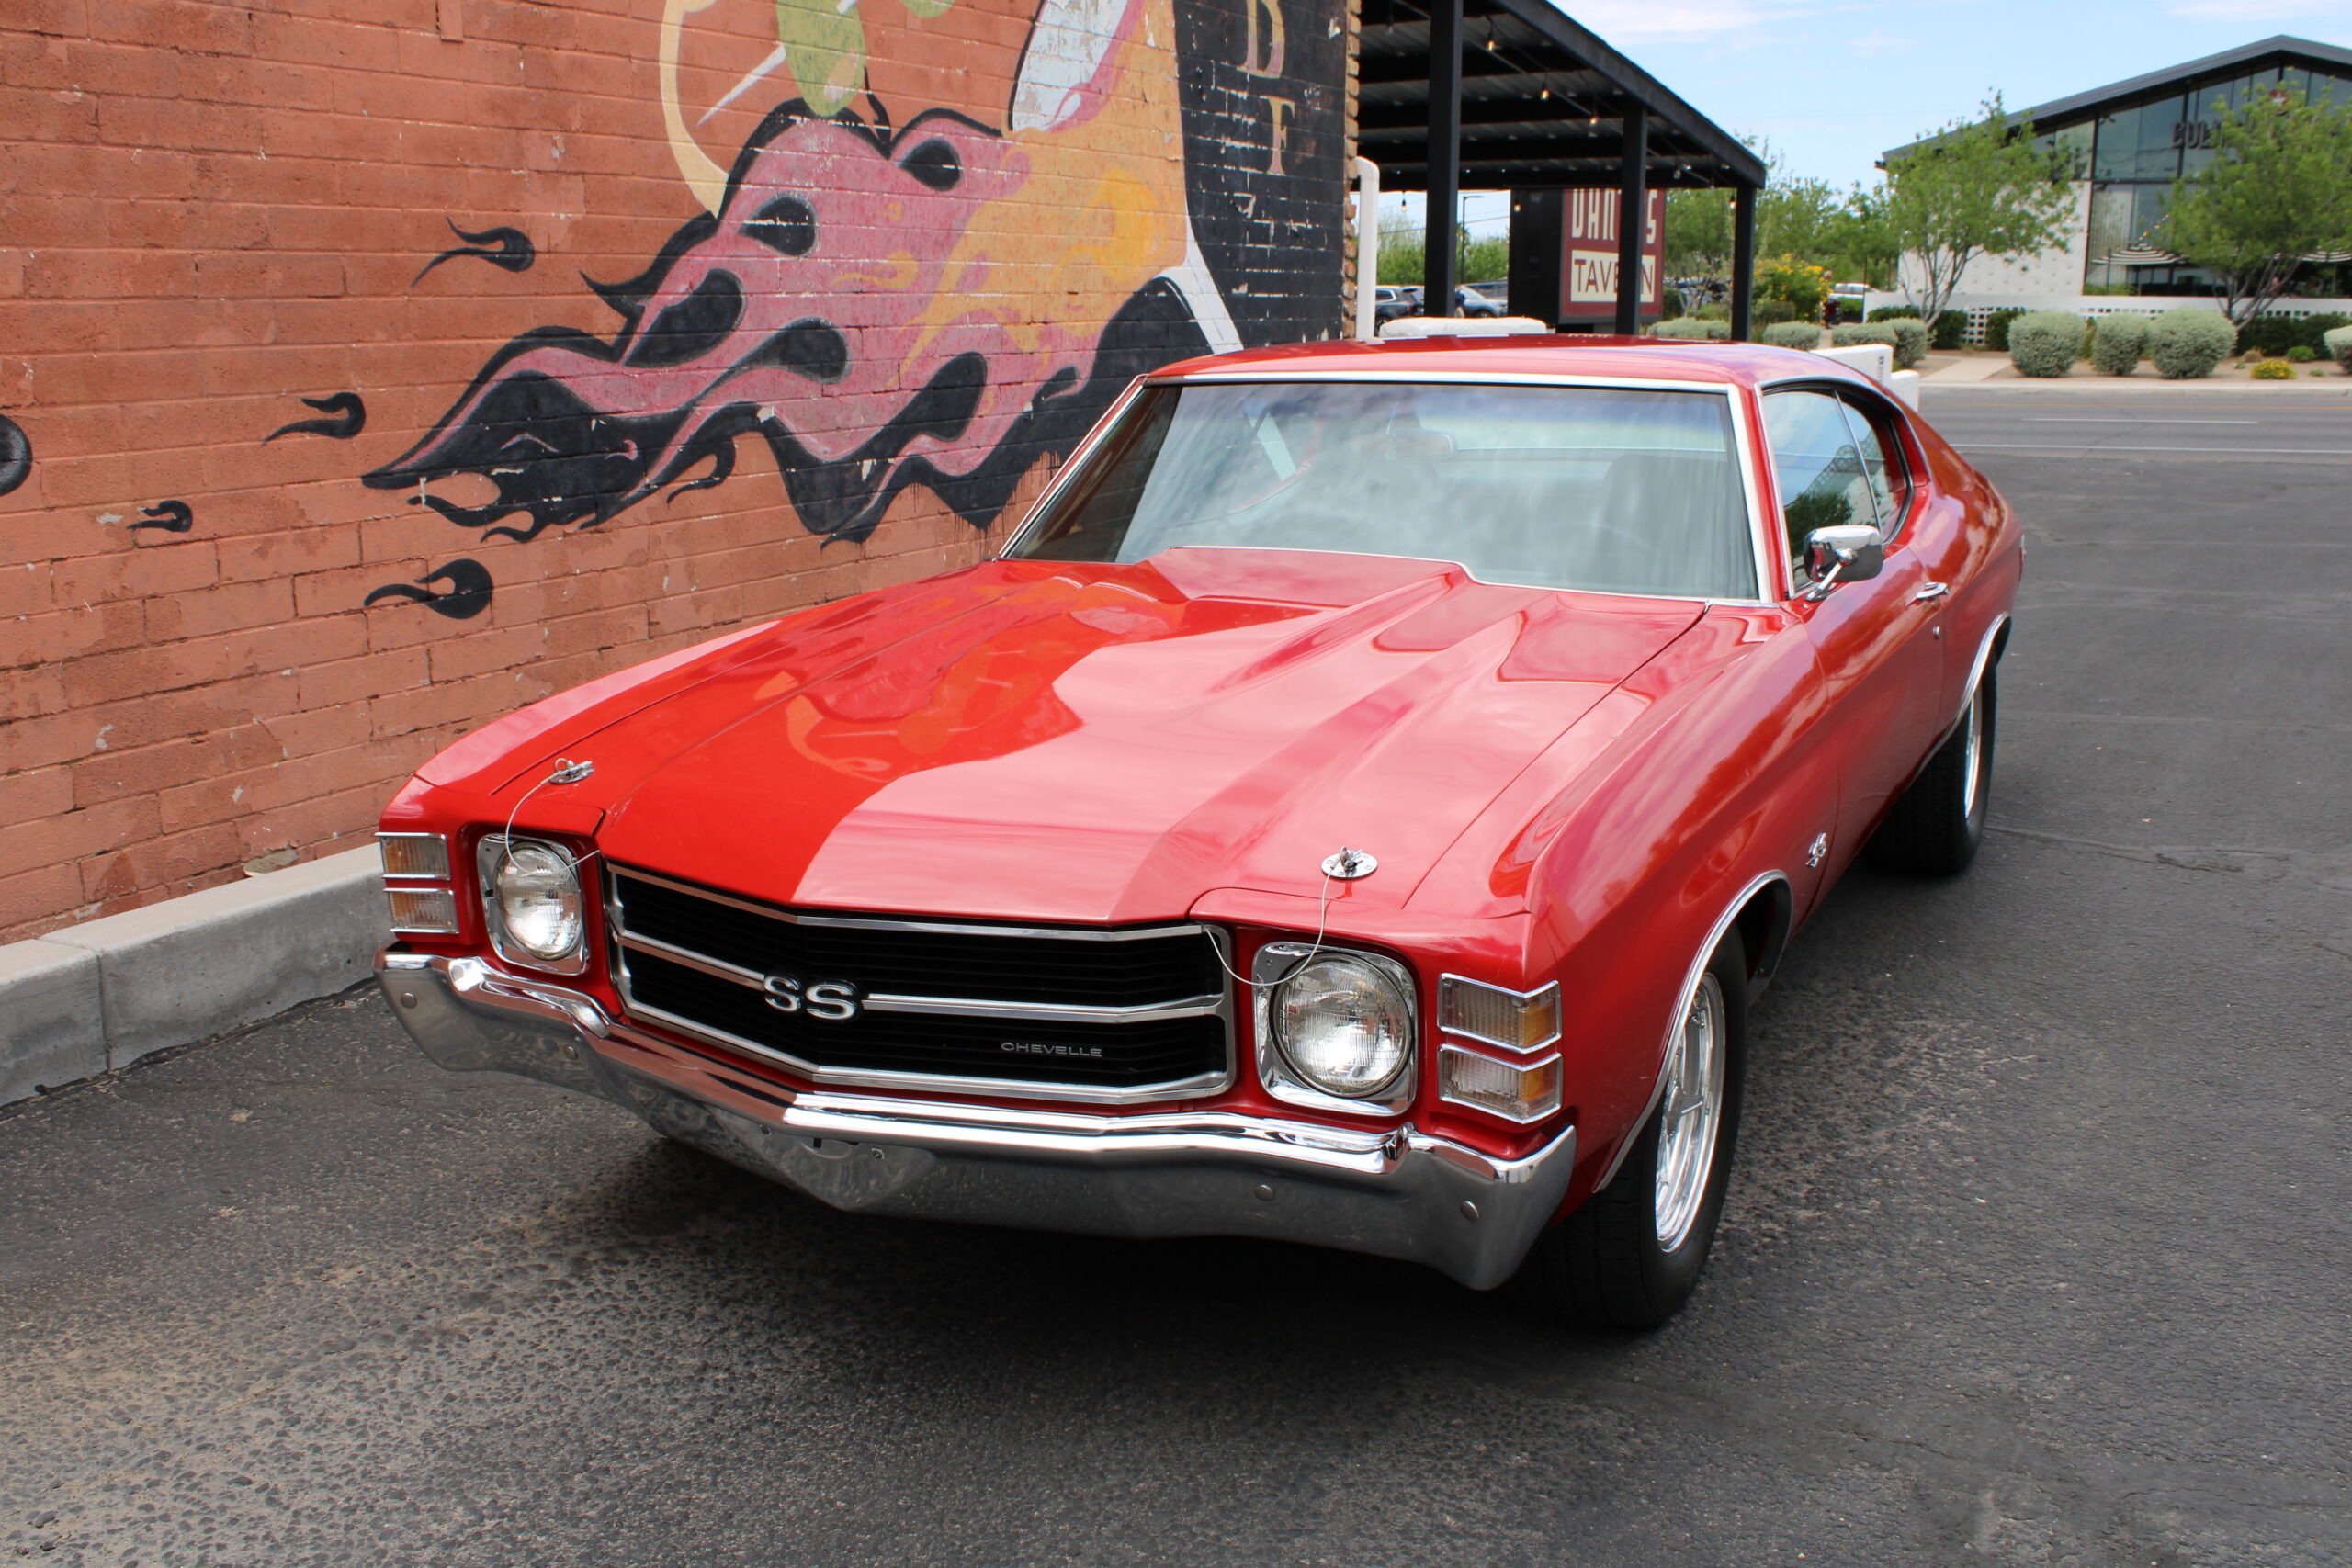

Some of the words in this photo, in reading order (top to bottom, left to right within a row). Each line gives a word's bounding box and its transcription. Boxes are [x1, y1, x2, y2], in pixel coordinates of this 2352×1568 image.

[1574, 258, 1654, 295] TAVEN
[763, 975, 856, 1021] SS
[1001, 1042, 1102, 1057] CHEVELLE
